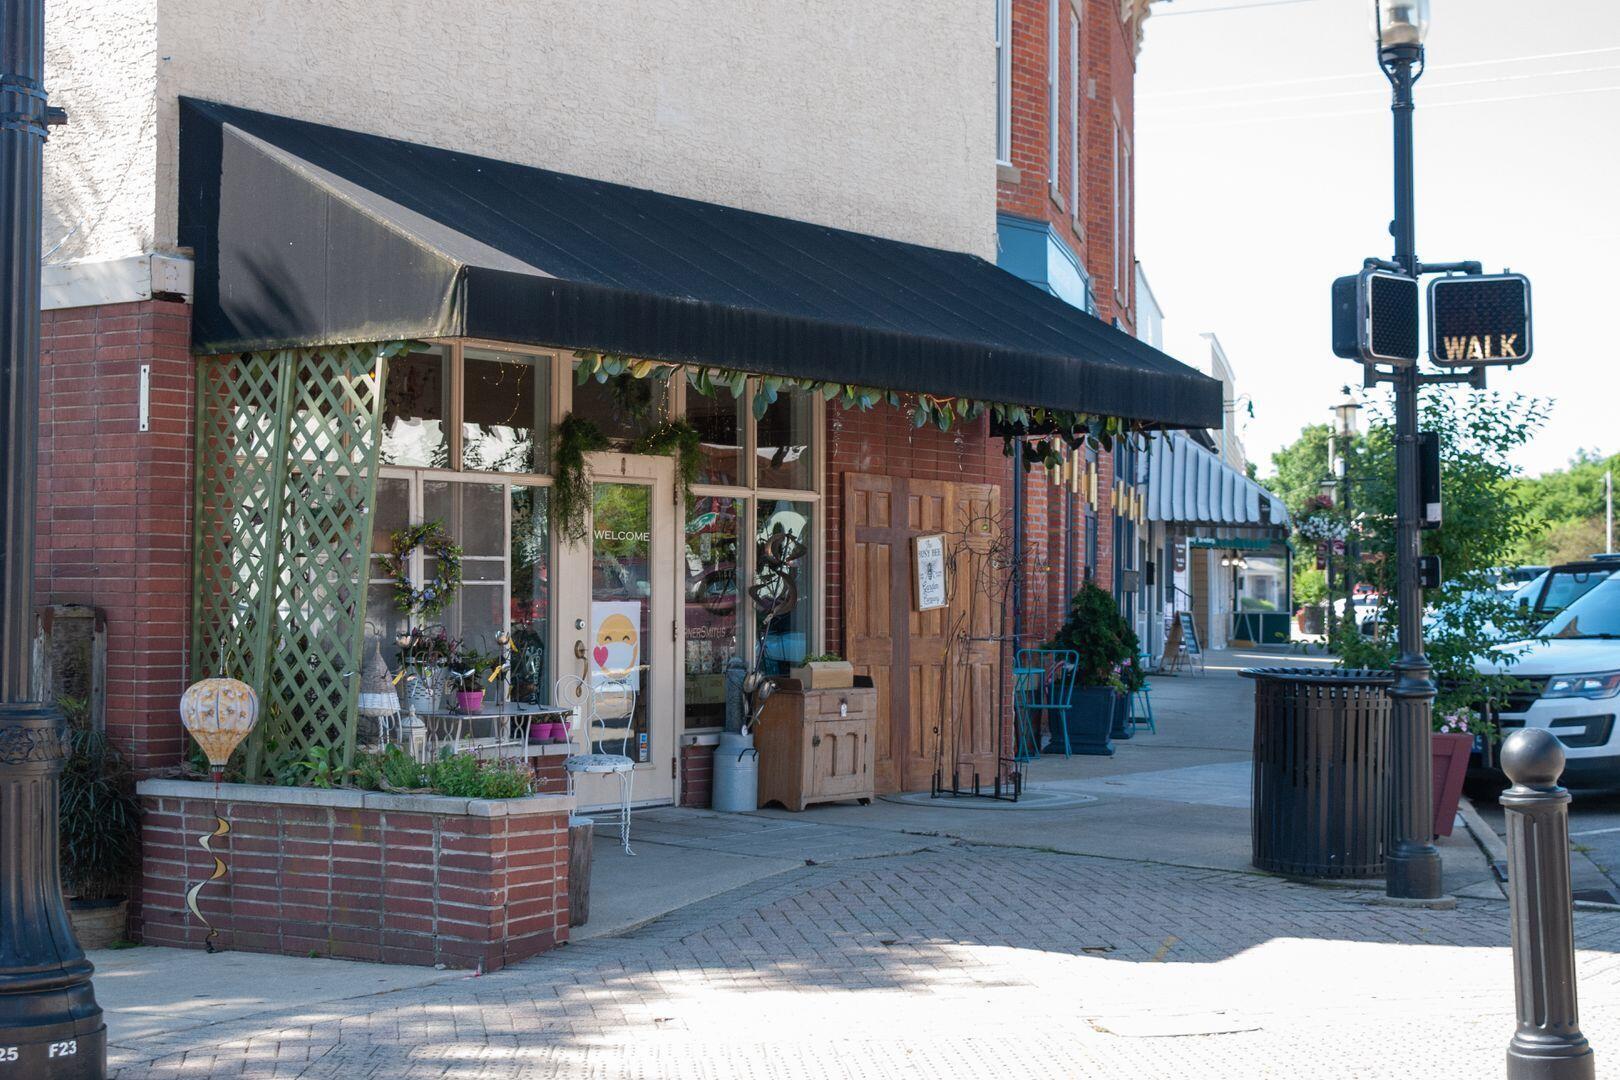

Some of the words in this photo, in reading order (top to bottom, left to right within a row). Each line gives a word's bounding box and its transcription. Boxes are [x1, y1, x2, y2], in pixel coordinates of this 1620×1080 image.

[1443, 333, 1518, 360] WALK
[594, 530, 650, 542] WELCOME
[49, 1041, 77, 1057] F23
